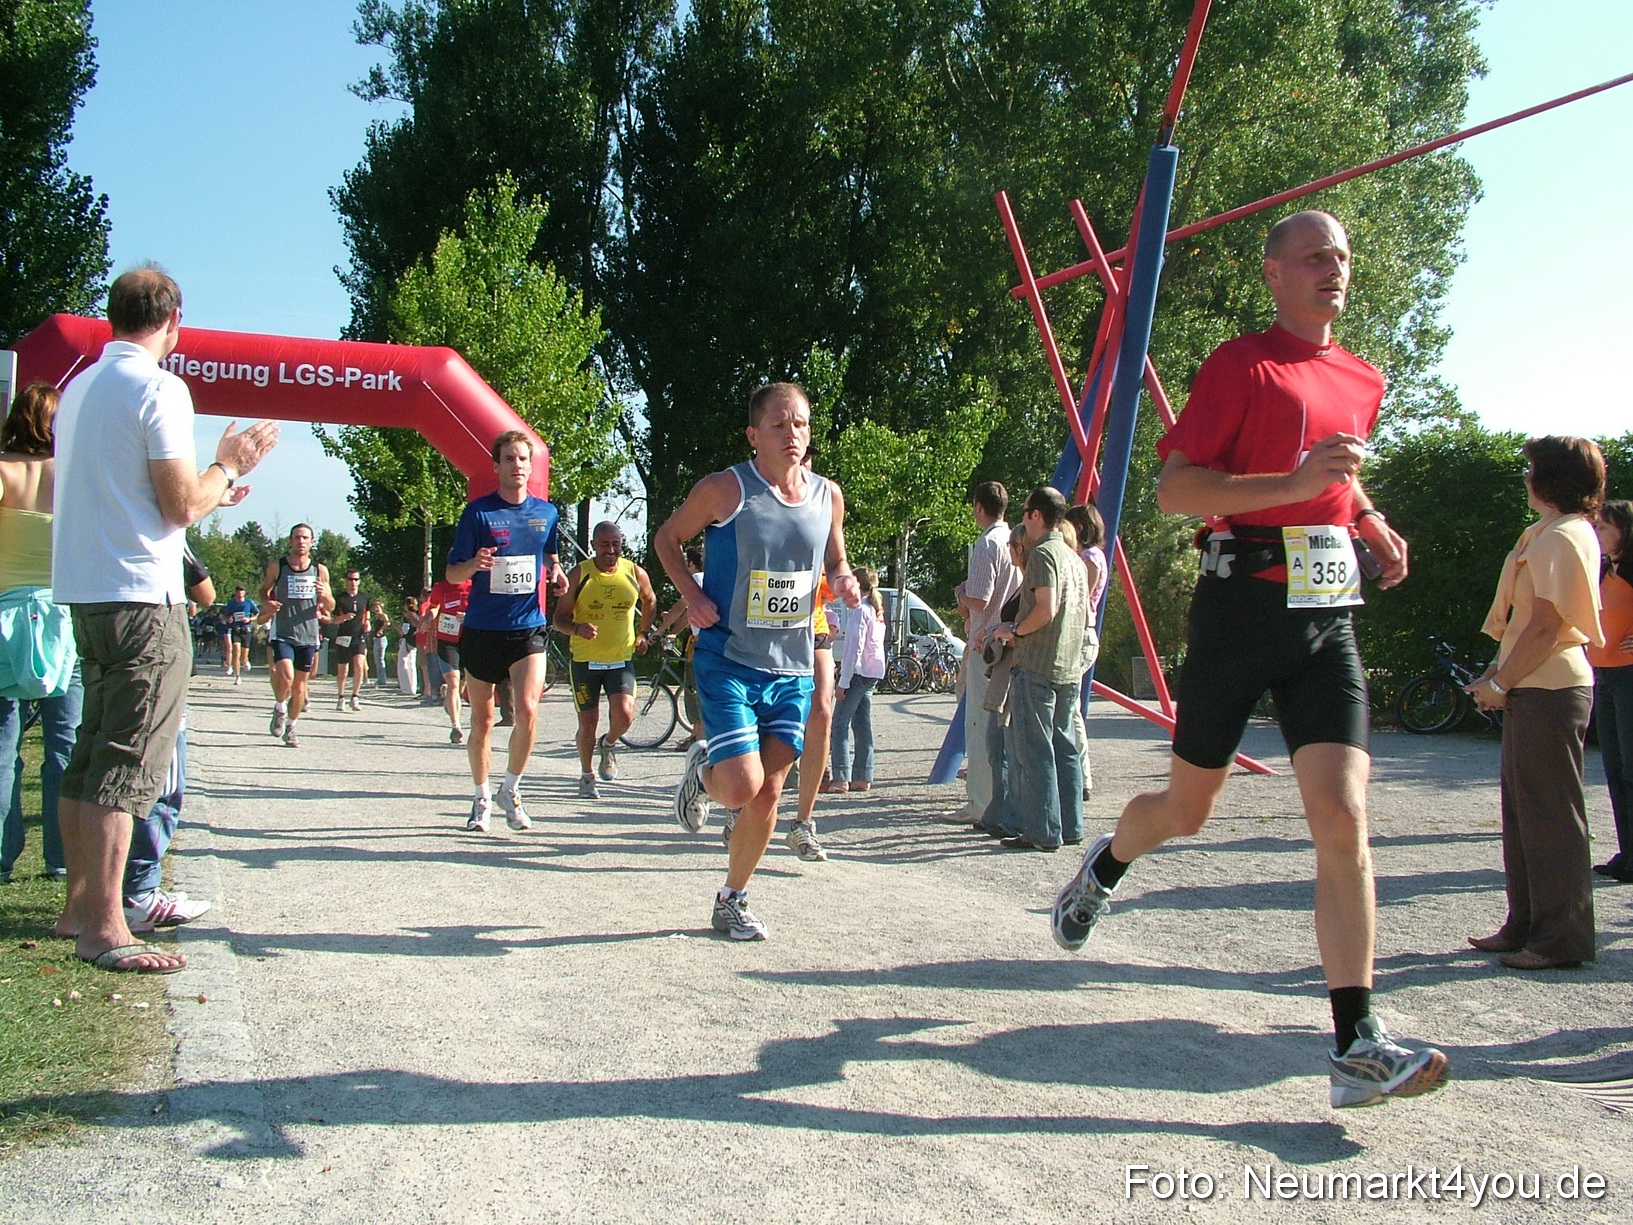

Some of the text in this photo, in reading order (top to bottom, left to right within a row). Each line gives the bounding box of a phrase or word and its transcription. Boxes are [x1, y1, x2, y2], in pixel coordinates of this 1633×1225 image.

[279, 362, 402, 391] LGS-Park
[504, 572, 532, 584] 3510
[1292, 556, 1347, 585] A 358
[767, 577, 795, 590] Georg
[752, 591, 799, 614] A 626
[443, 621, 455, 630] 359
